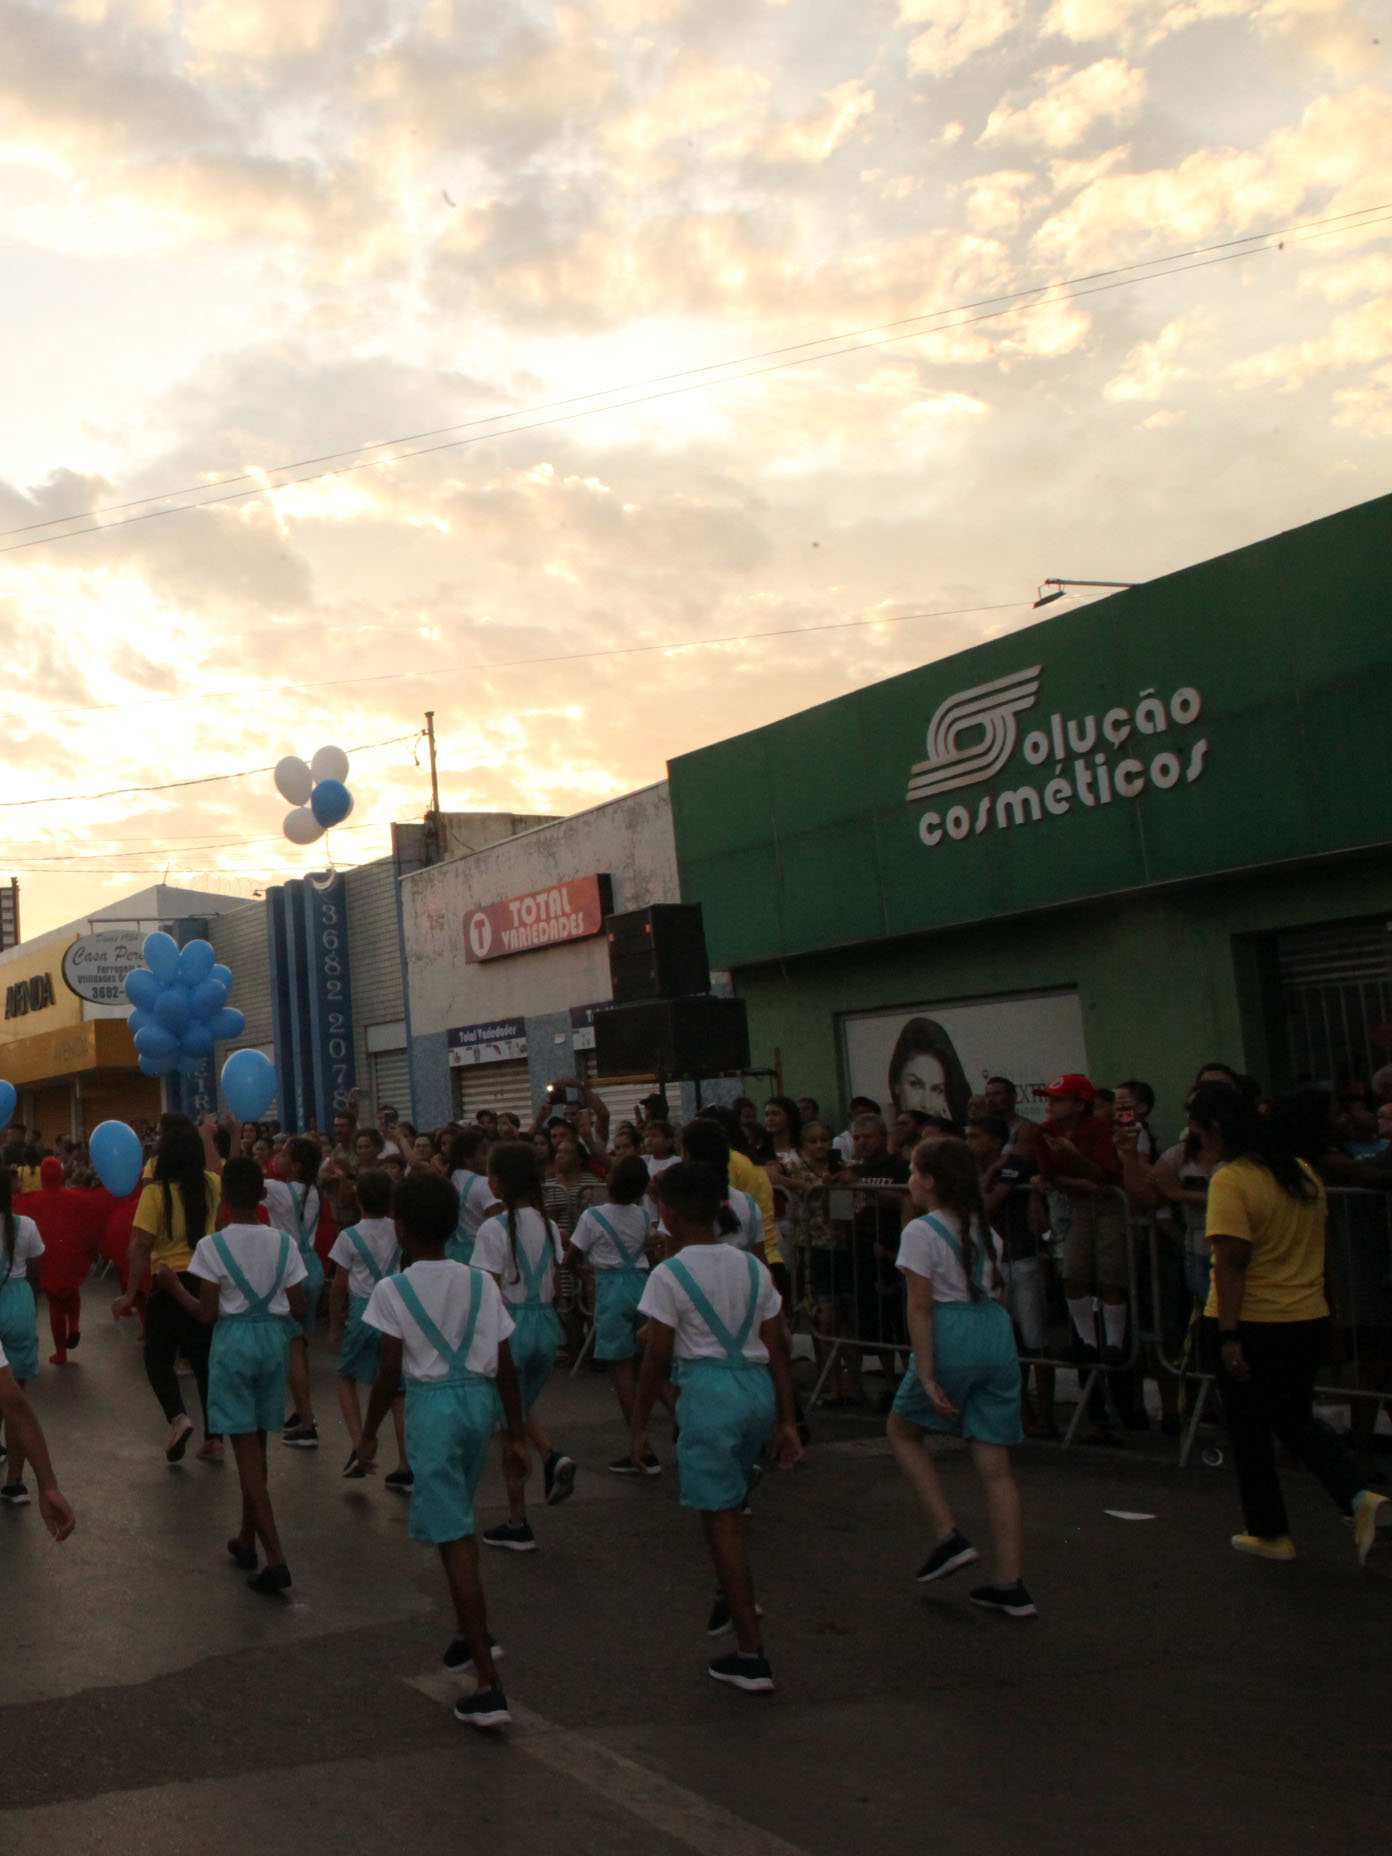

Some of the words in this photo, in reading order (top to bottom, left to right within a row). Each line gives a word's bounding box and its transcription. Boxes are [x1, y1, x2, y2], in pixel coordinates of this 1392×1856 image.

[919, 738, 1208, 846] cosméticos
[509, 887, 571, 927] TOTAL
[501, 912, 584, 951] VARIEDADES
[72, 945, 107, 967] Casa
